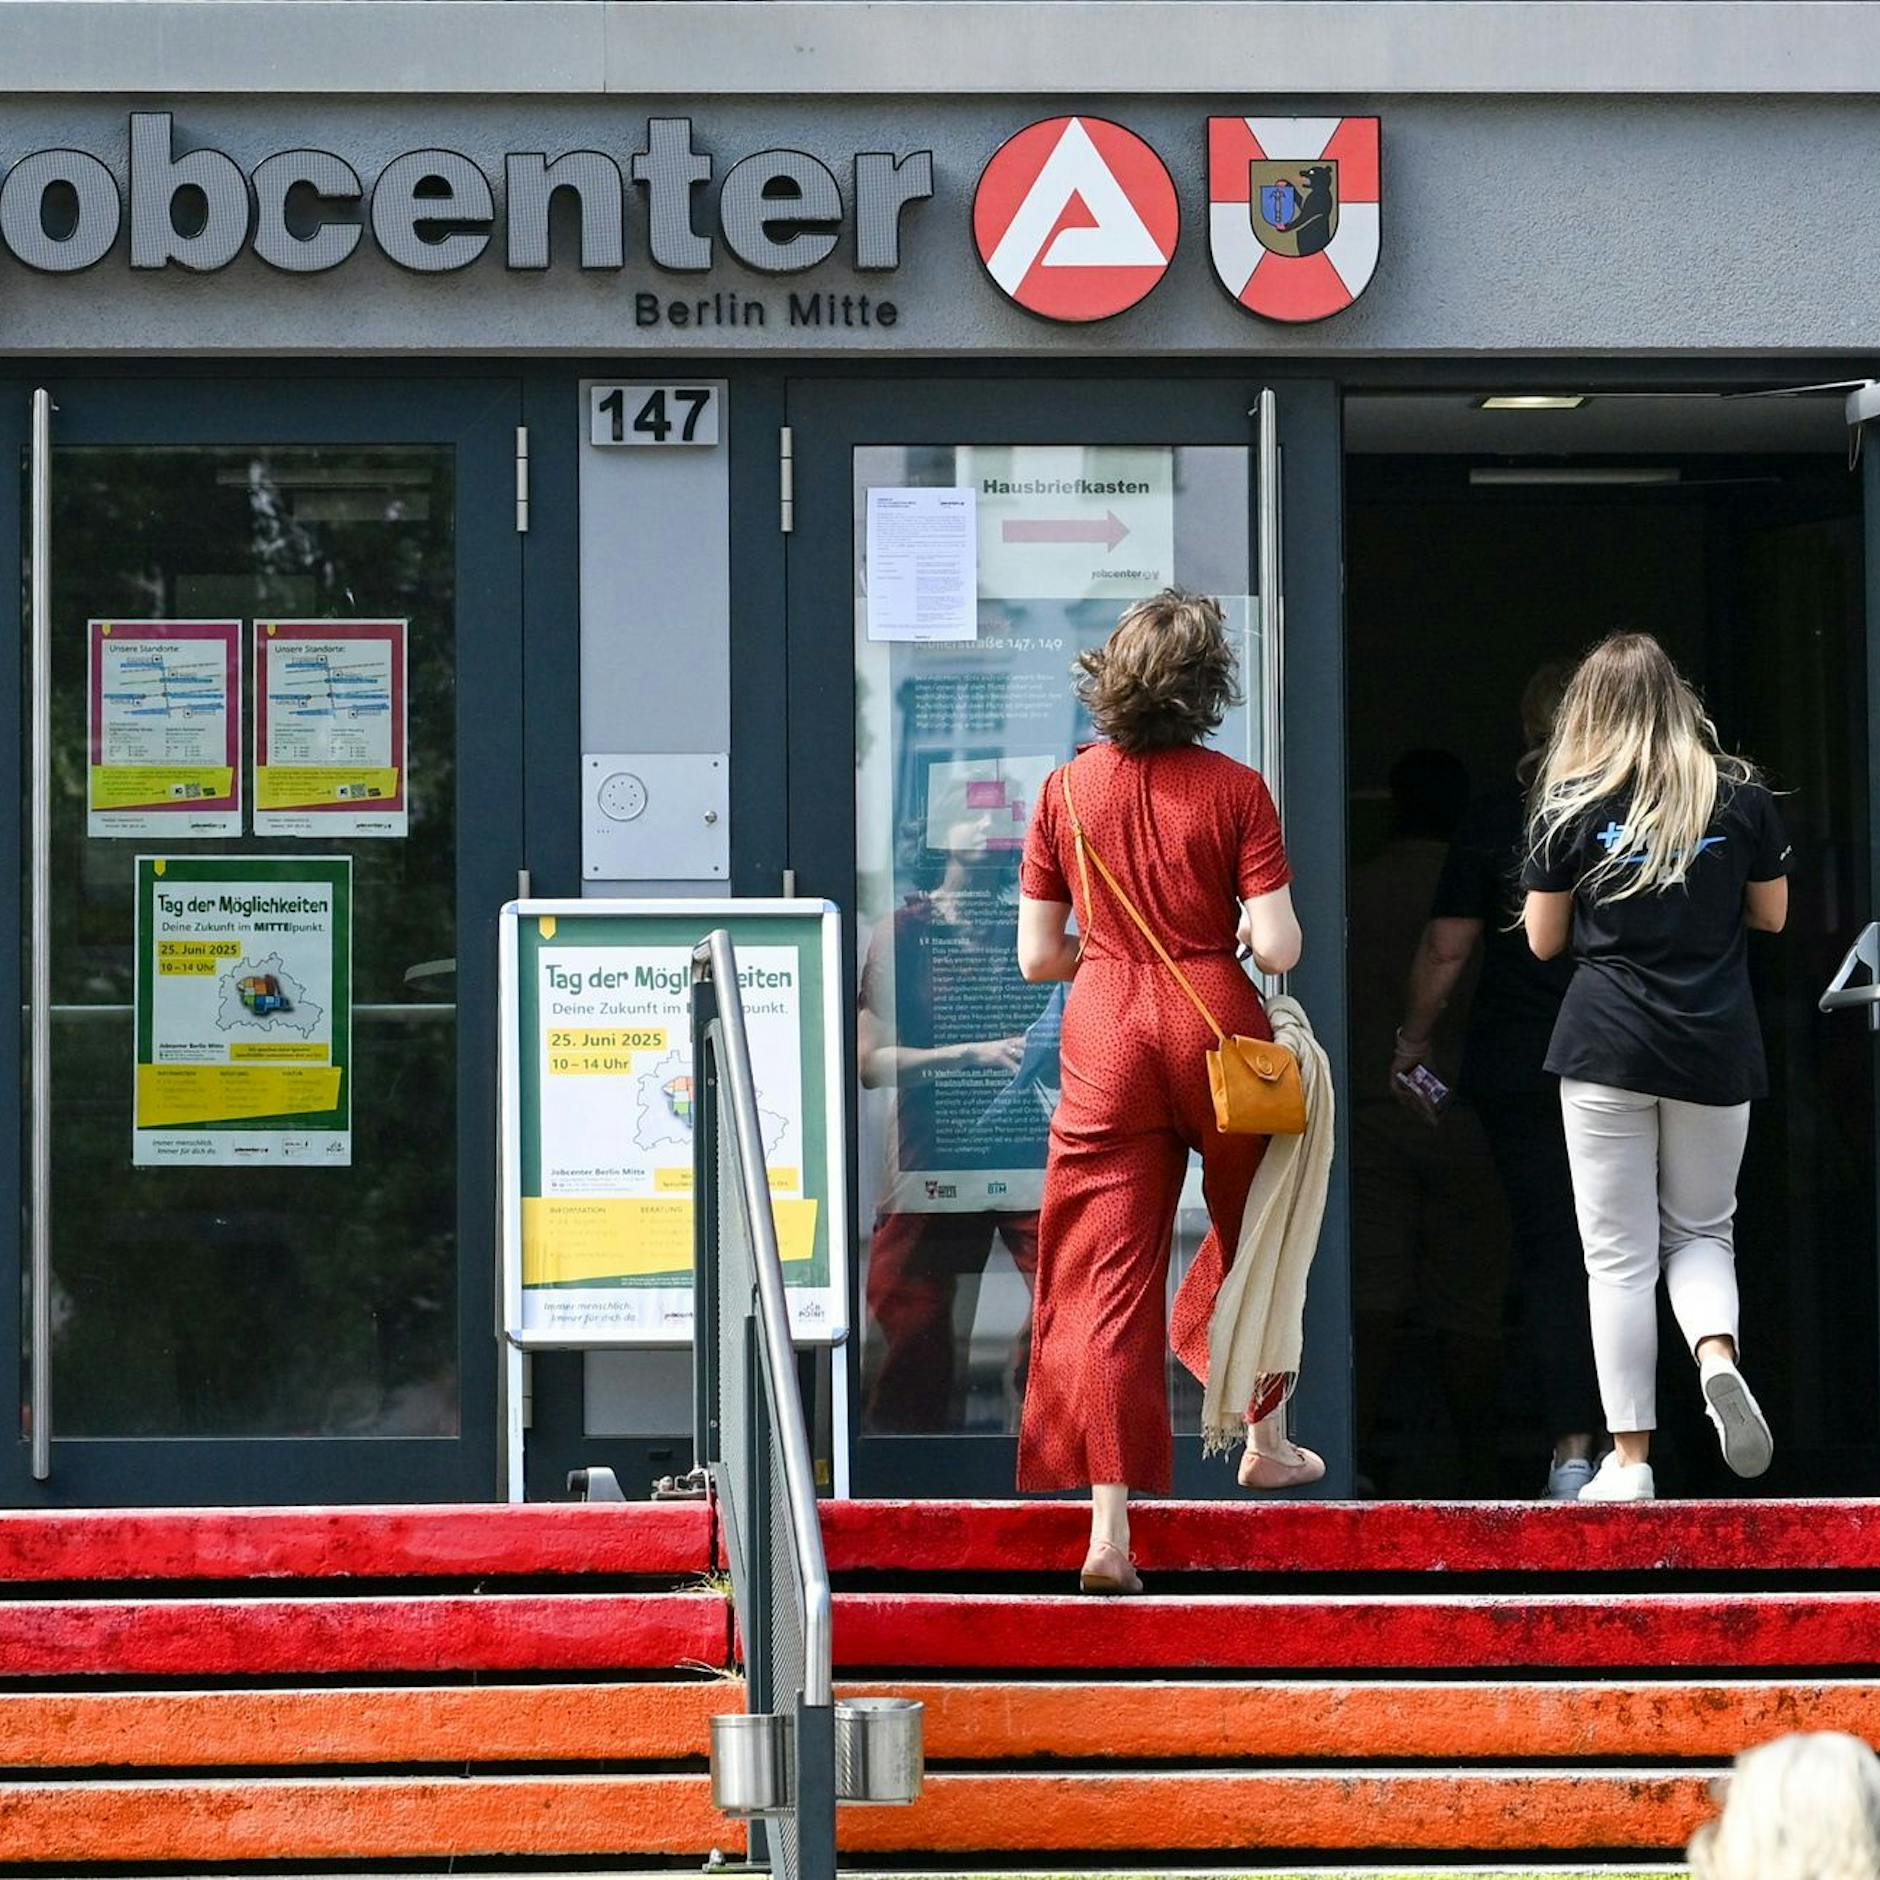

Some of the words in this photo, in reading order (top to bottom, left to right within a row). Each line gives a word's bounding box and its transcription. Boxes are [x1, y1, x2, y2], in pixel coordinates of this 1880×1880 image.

[0, 112, 933, 271] obcenter
[635, 293, 765, 326] Berlin
[789, 293, 898, 326] Mitte
[599, 390, 710, 441] 147
[983, 479, 1150, 495] Hausbriefkasten
[1091, 568, 1142, 580] jobcenter
[157, 894, 183, 917] Tag
[187, 895, 215, 913] der
[219, 894, 328, 917] Möglichkeiten
[162, 922, 192, 932] Deine
[194, 922, 235, 932] Zukunft
[238, 922, 250, 932] im
[161, 944, 179, 955] 25.
[181, 944, 206, 956] Juni
[209, 944, 238, 955] 2025
[197, 963, 214, 971] Uhr
[546, 965, 582, 995] Tag
[589, 966, 629, 989] der
[635, 965, 792, 995] Mögleiten
[552, 1002, 595, 1015] Deine
[599, 1002, 658, 1015] Zukunft
[663, 1002, 681, 1015] im
[552, 1033, 577, 1047] 25.
[582, 1033, 616, 1047] Juni
[621, 1033, 662, 1047] 2025
[552, 1058, 568, 1070] 10
[582, 1058, 599, 1070] 14
[603, 1058, 629, 1070] Uhr
[551, 1168, 592, 1176] Jobcenter
[595, 1168, 620, 1176] Berlin
[622, 1168, 645, 1176] Mitte
